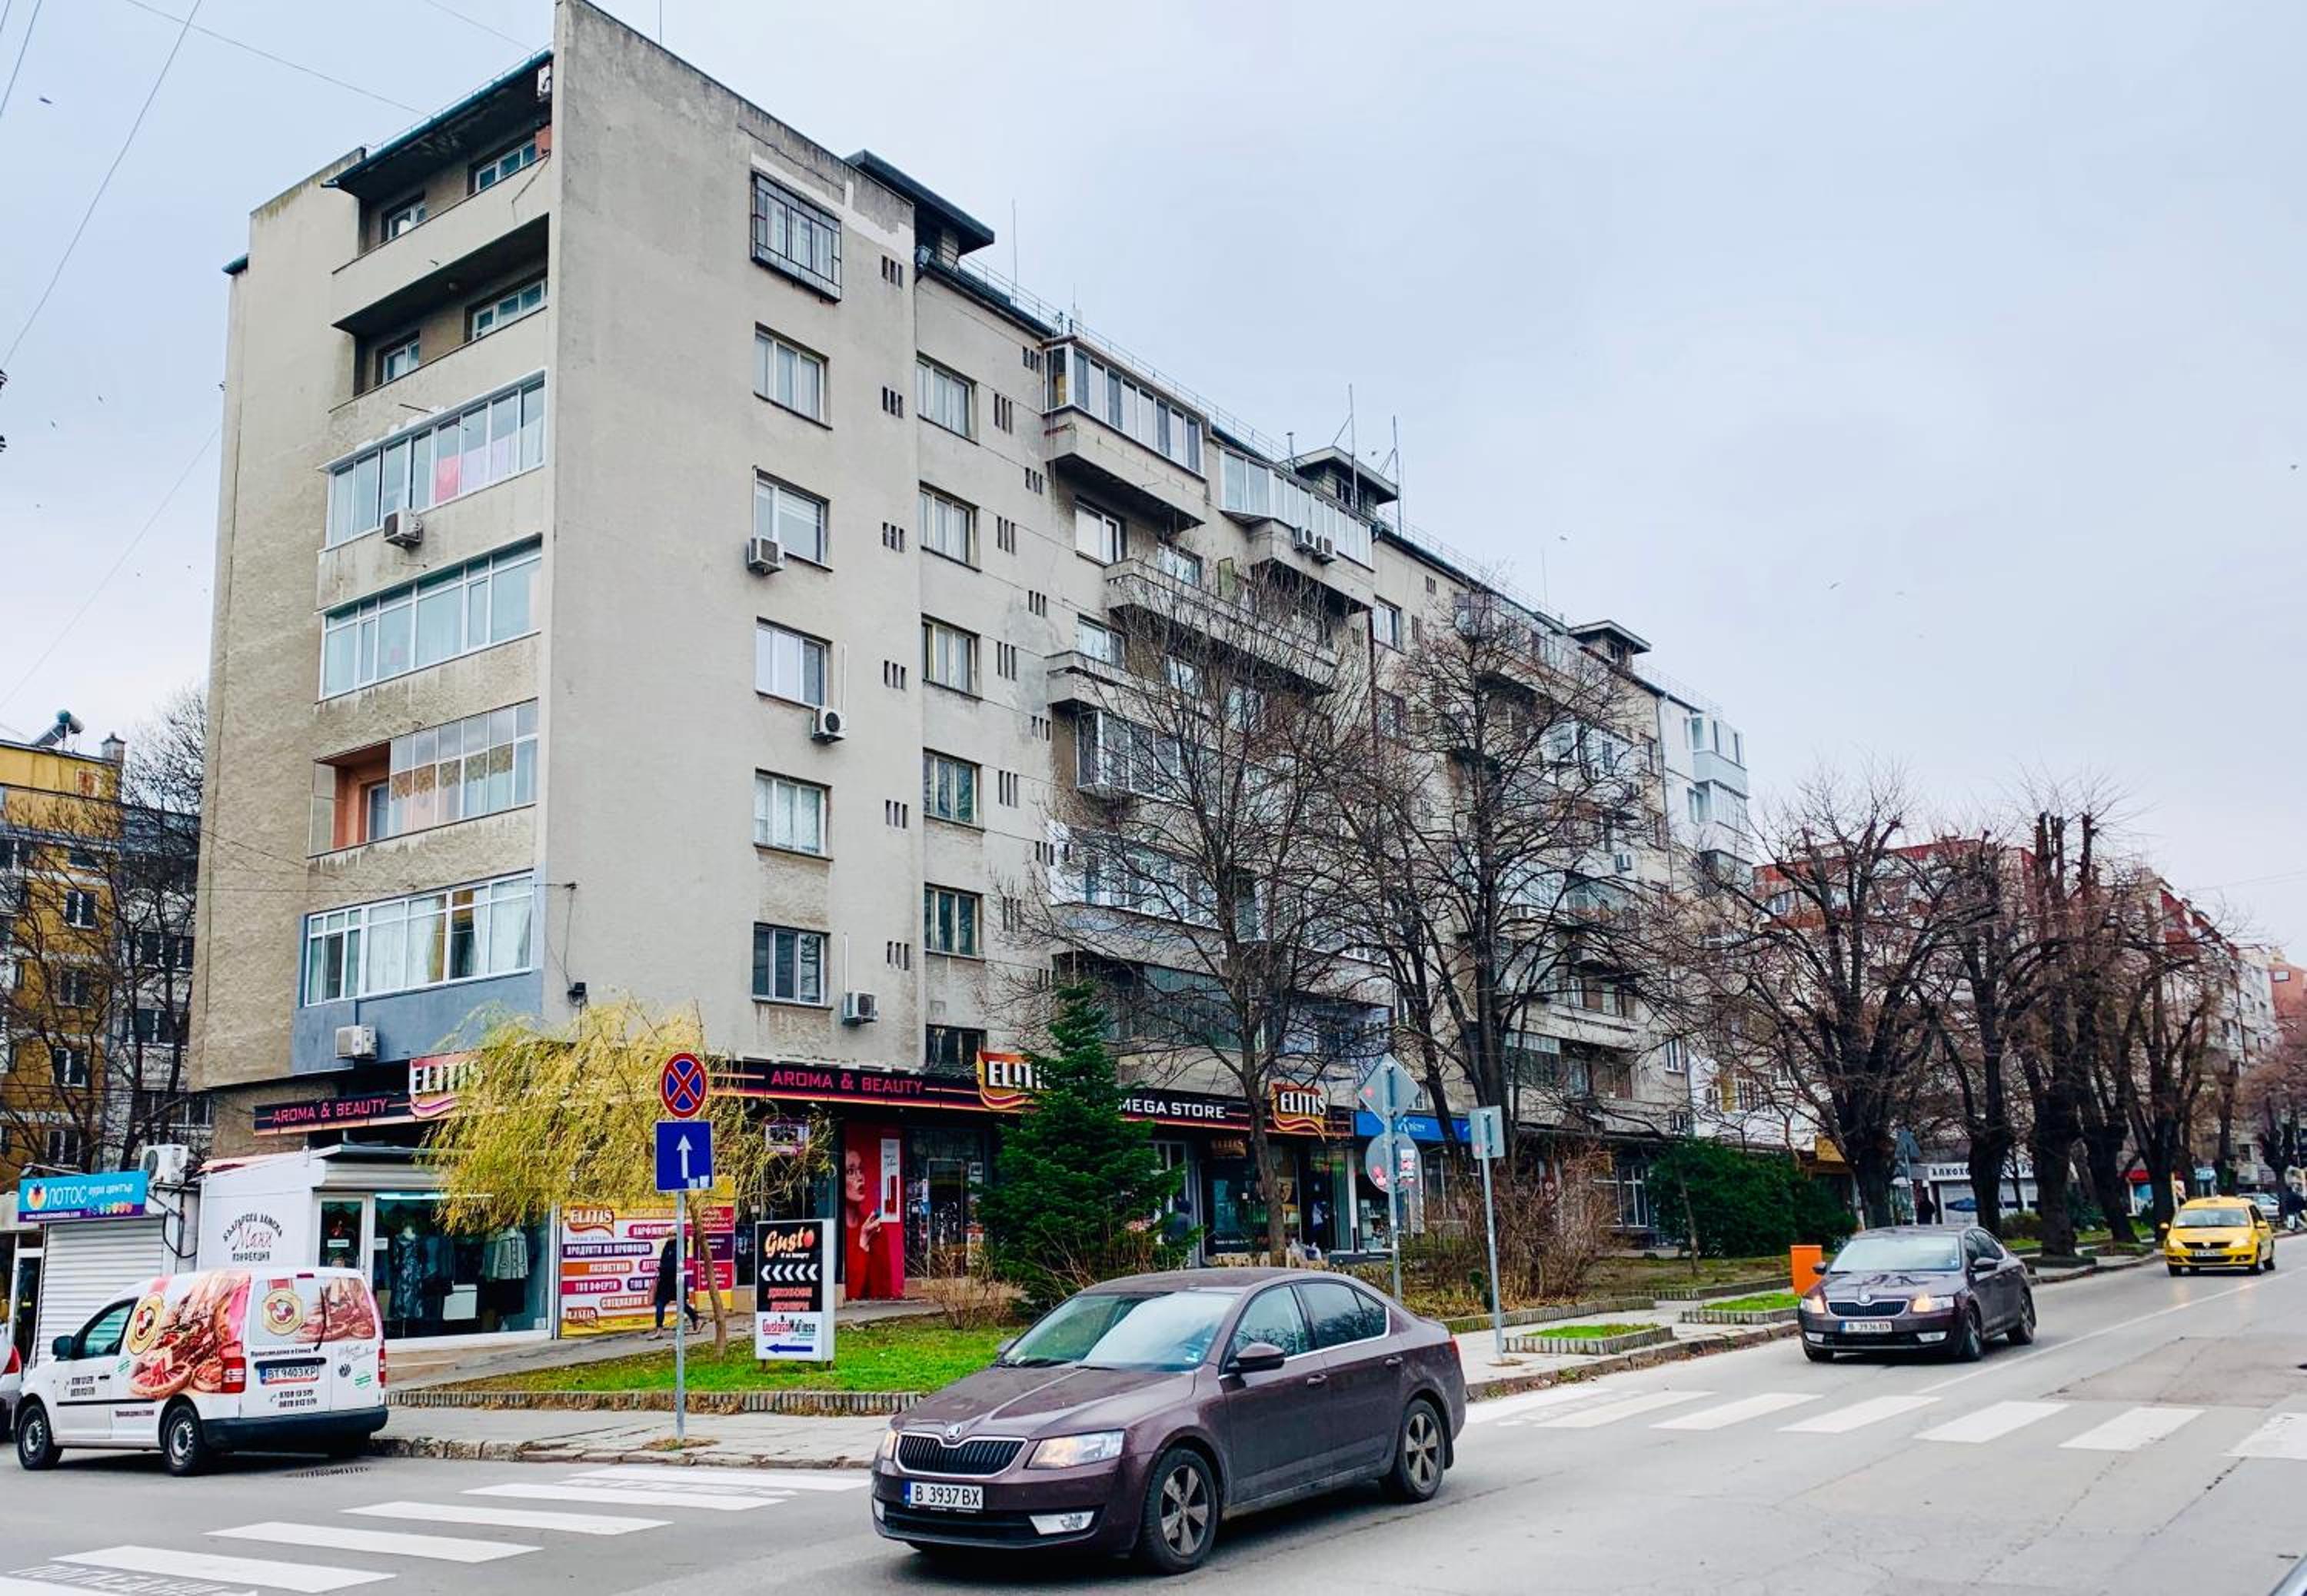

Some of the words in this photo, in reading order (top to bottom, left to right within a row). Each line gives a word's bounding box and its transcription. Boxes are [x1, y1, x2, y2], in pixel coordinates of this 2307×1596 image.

[771, 1070, 833, 1089] AROMA
[841, 1073, 854, 1090] &
[861, 1077, 922, 1094] BEAUTY
[273, 1108, 315, 1123] AROMA
[321, 1102, 331, 1118] &
[336, 1098, 388, 1116] BEAUTY
[1118, 1098, 1167, 1114] MEGA
[1171, 1103, 1226, 1119] STORE
[1280, 1091, 1327, 1115] ELITIS
[1932, 1168, 1969, 1177] АЛКОХО
[571, 1209, 612, 1223] ELITIS
[267, 1368, 278, 1378] BT
[916, 1485, 923, 1501] B
